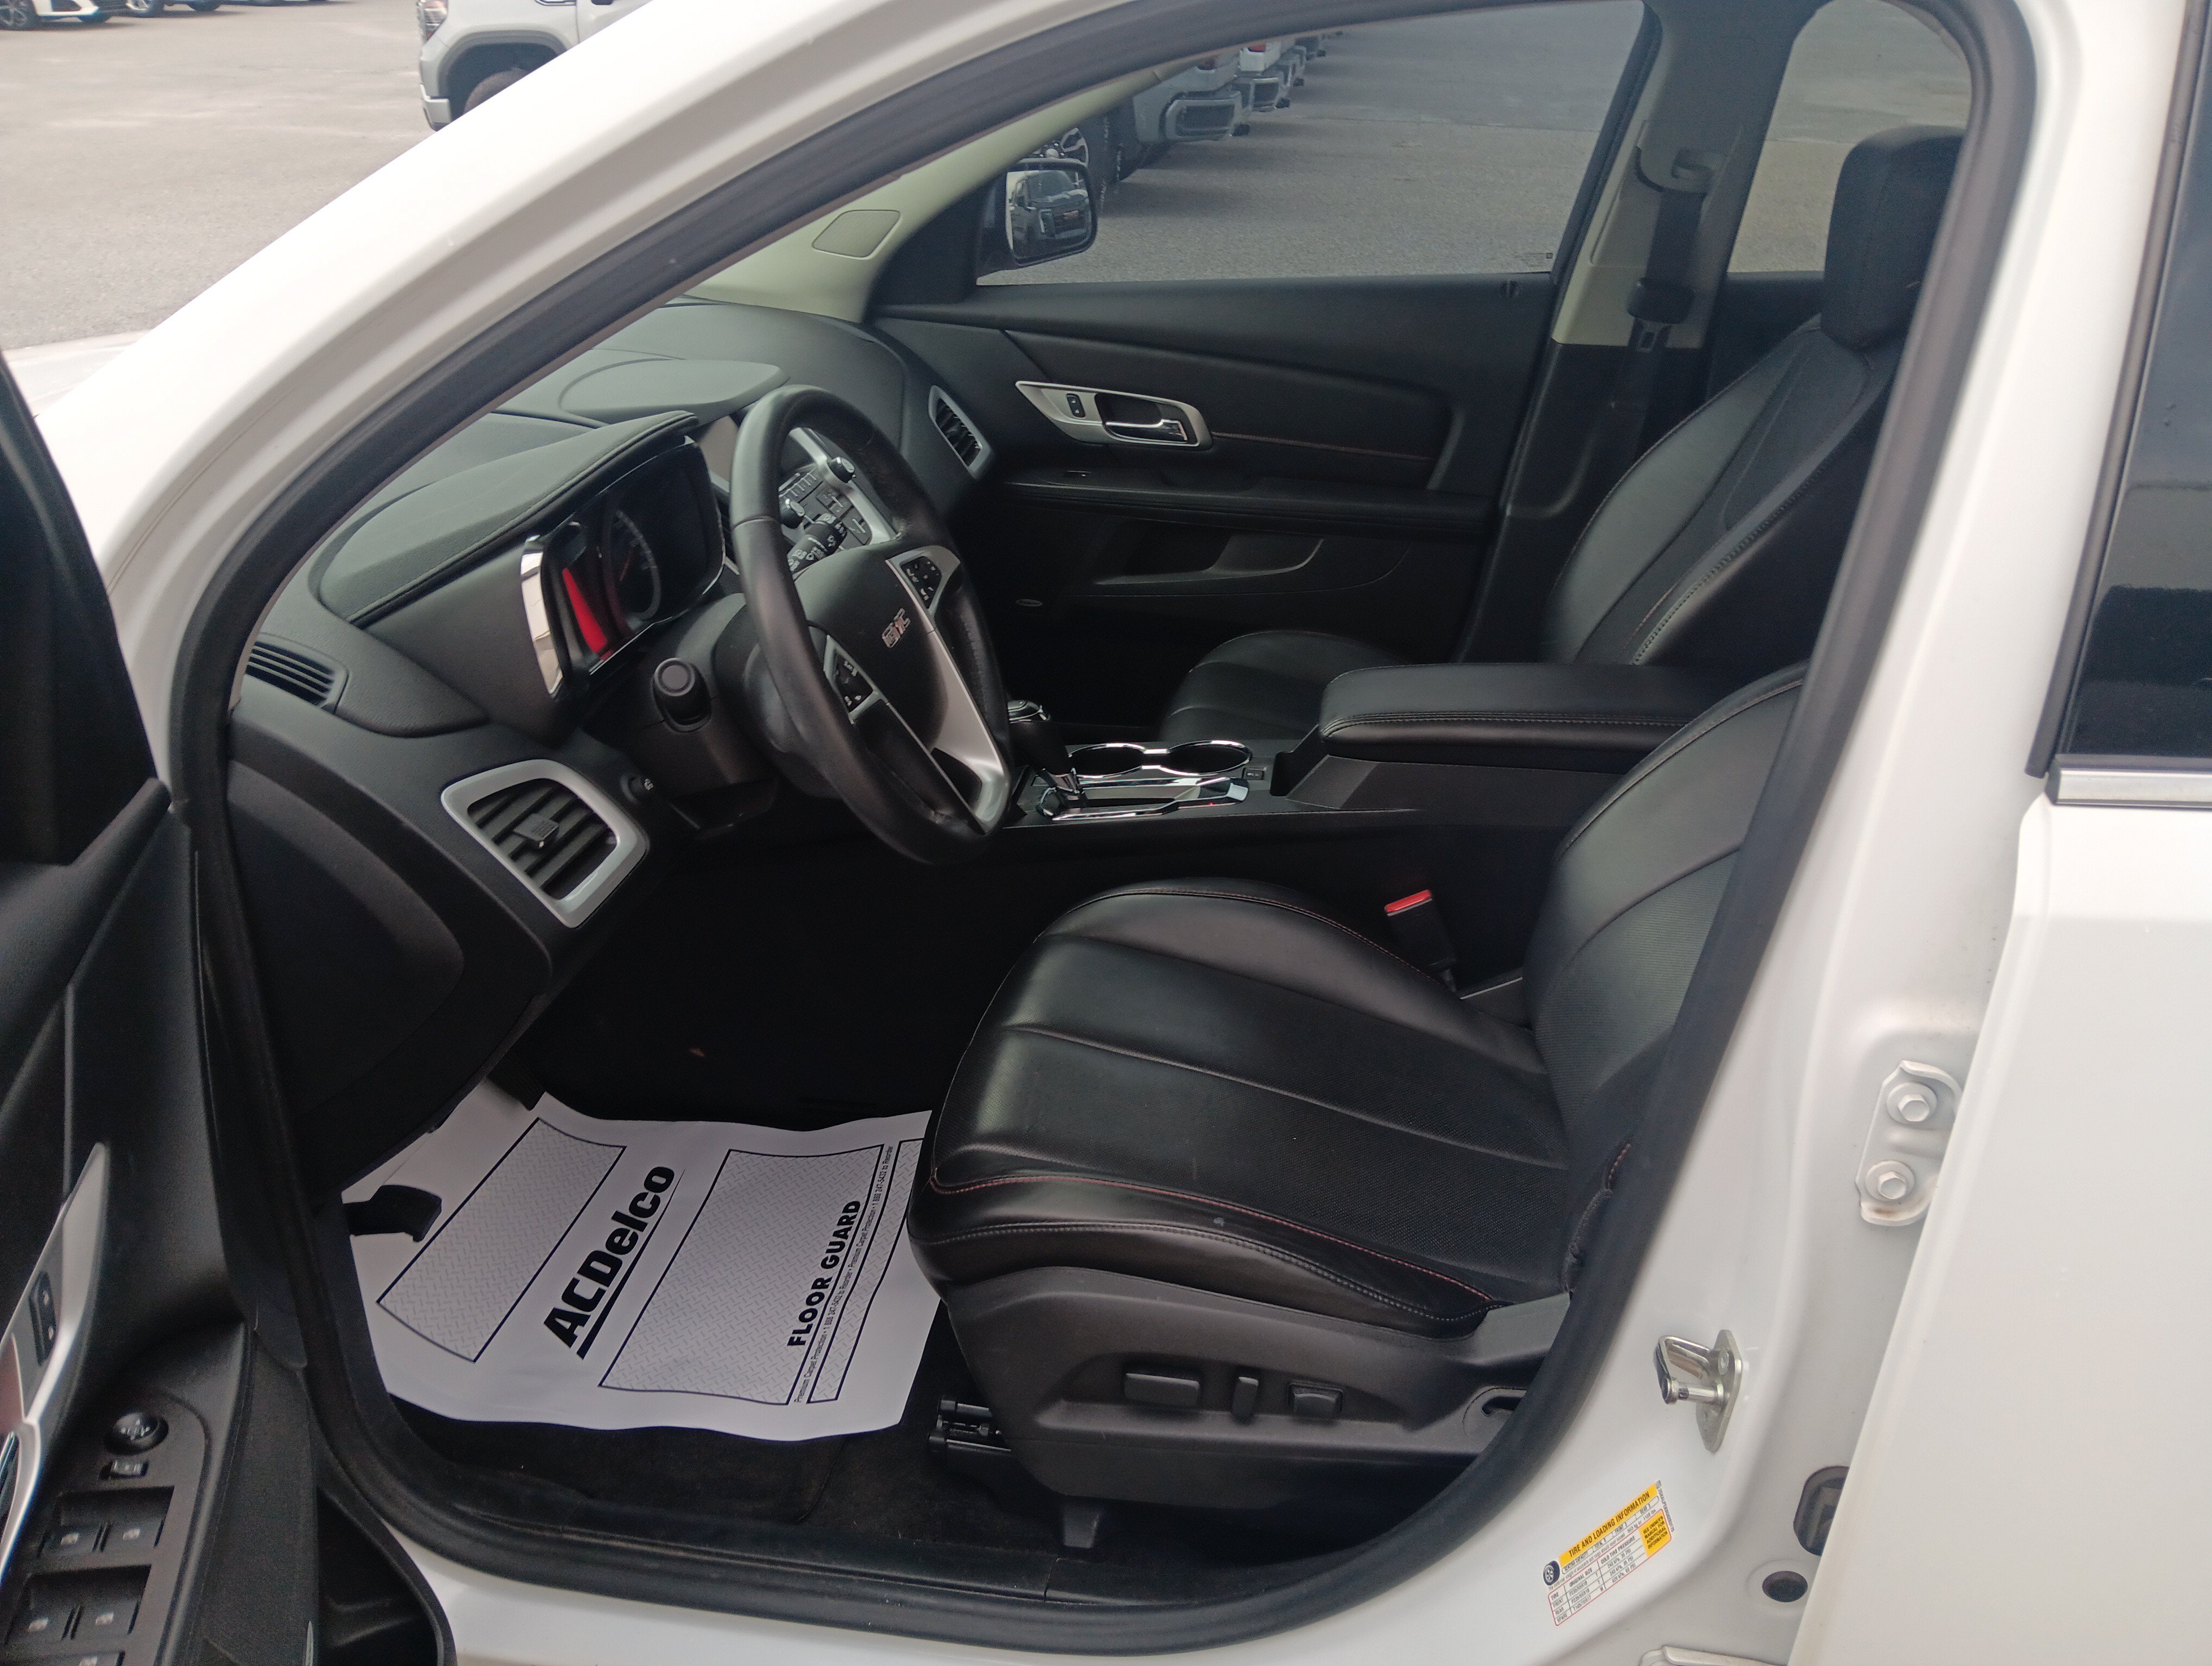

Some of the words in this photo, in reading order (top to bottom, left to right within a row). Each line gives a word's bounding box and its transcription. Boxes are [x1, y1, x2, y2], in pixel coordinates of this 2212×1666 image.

[543, 1166, 675, 1349] ACDelco
[787, 1276, 833, 1347] FLOOR
[820, 1201, 861, 1269] GUARD
[1568, 1545, 1581, 1558] TIRE
[1582, 1537, 1593, 1549] AND
[1593, 1518, 1616, 1540] LOADING
[1615, 1491, 1650, 1523] INFORMATION
